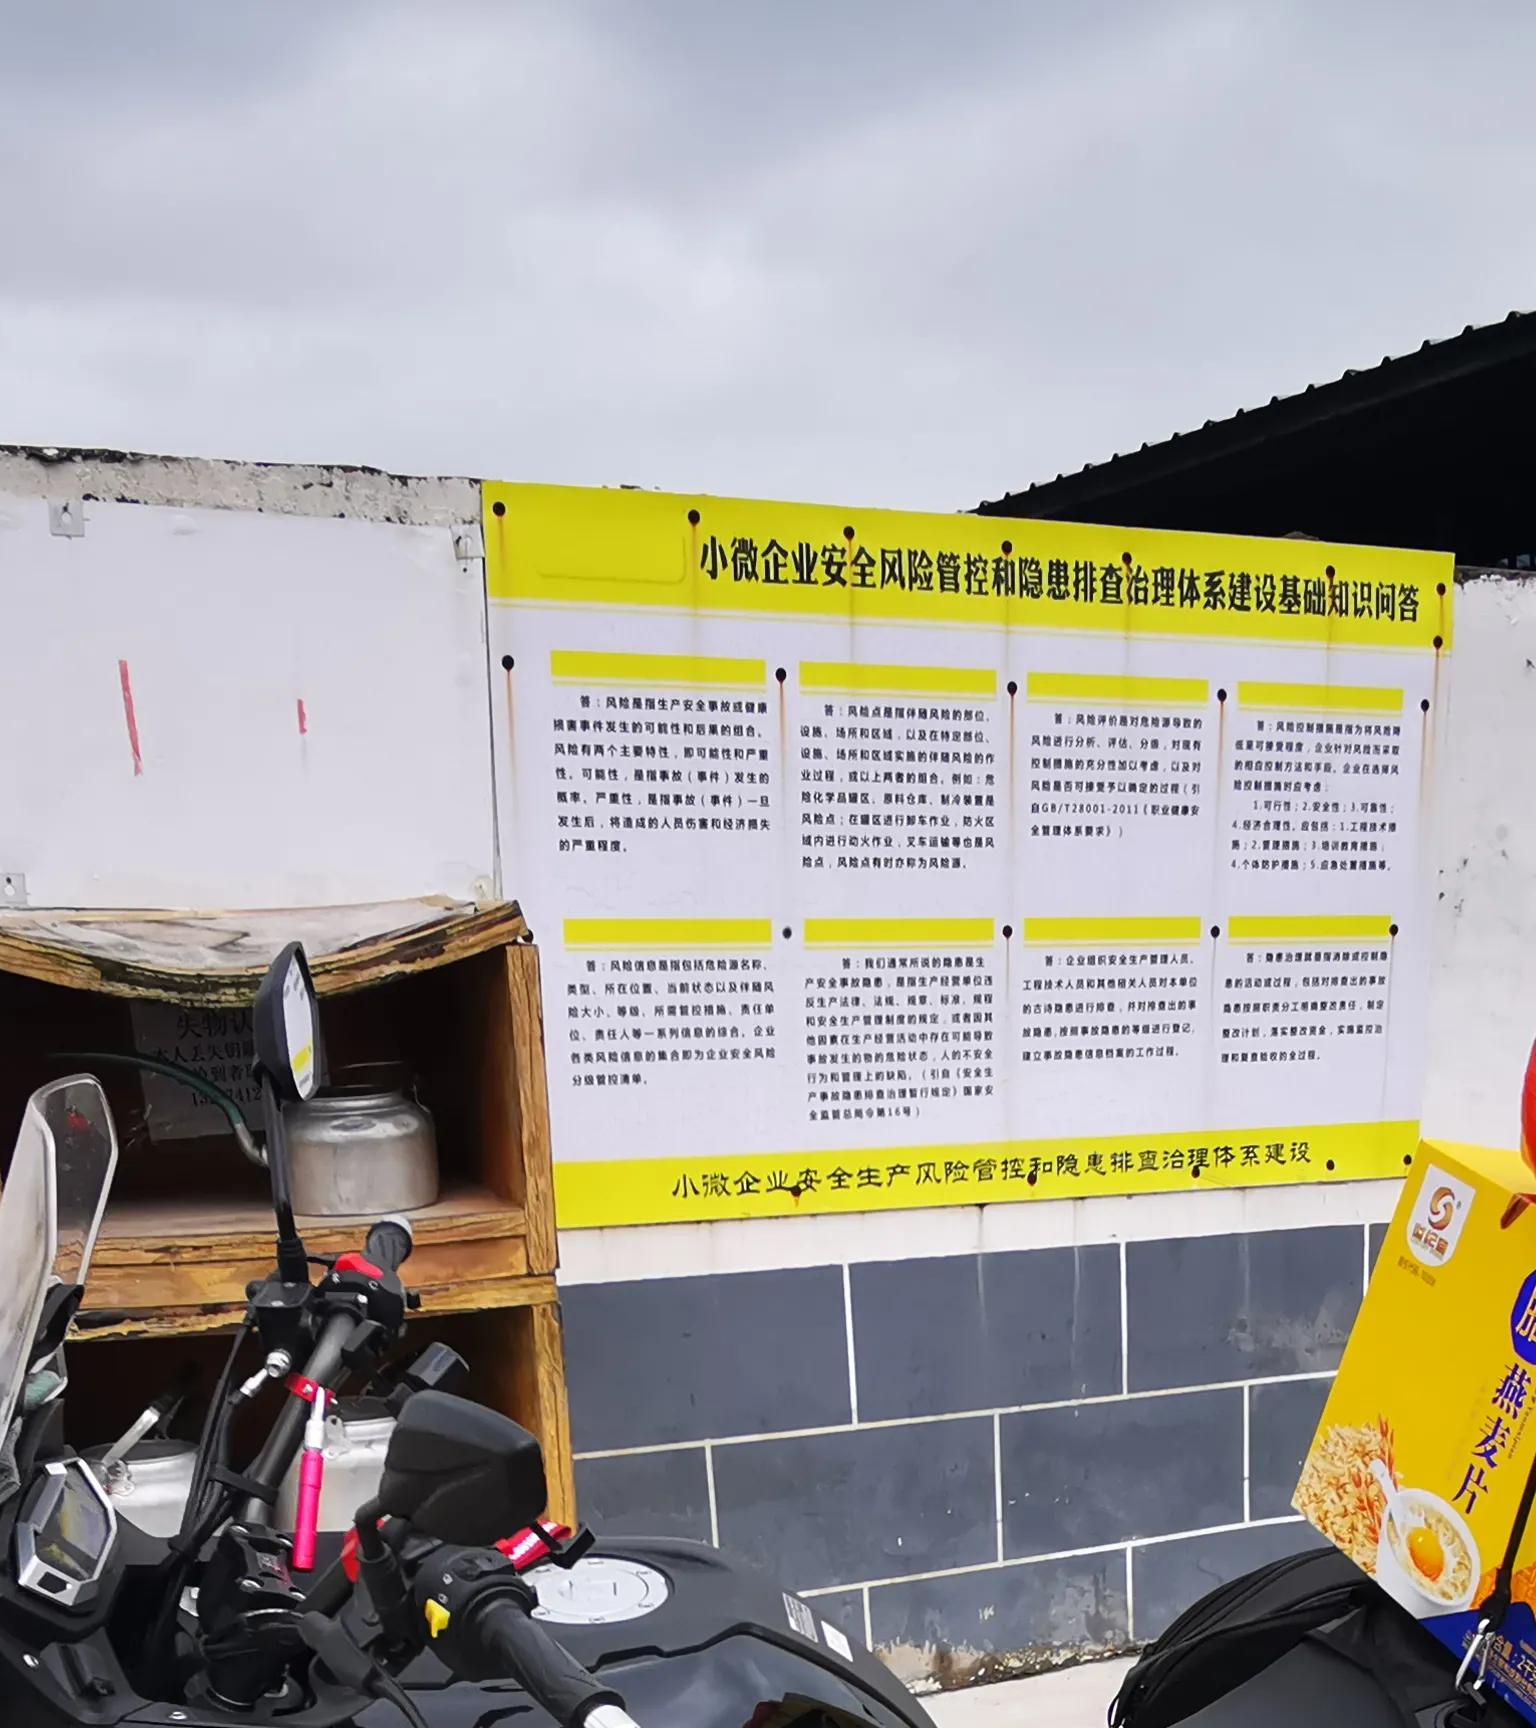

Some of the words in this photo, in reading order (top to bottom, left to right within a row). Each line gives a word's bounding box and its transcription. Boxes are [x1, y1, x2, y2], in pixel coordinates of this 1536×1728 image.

[699, 533, 1420, 623] 小微企业安全风险管控和隐患排查治理体系建设基础知识问答
[671, 1141, 1311, 1198] 小微企业安全生产风险管控和隐患排查治理体系建设
[1451, 1362, 1531, 1515] 燕麦片
